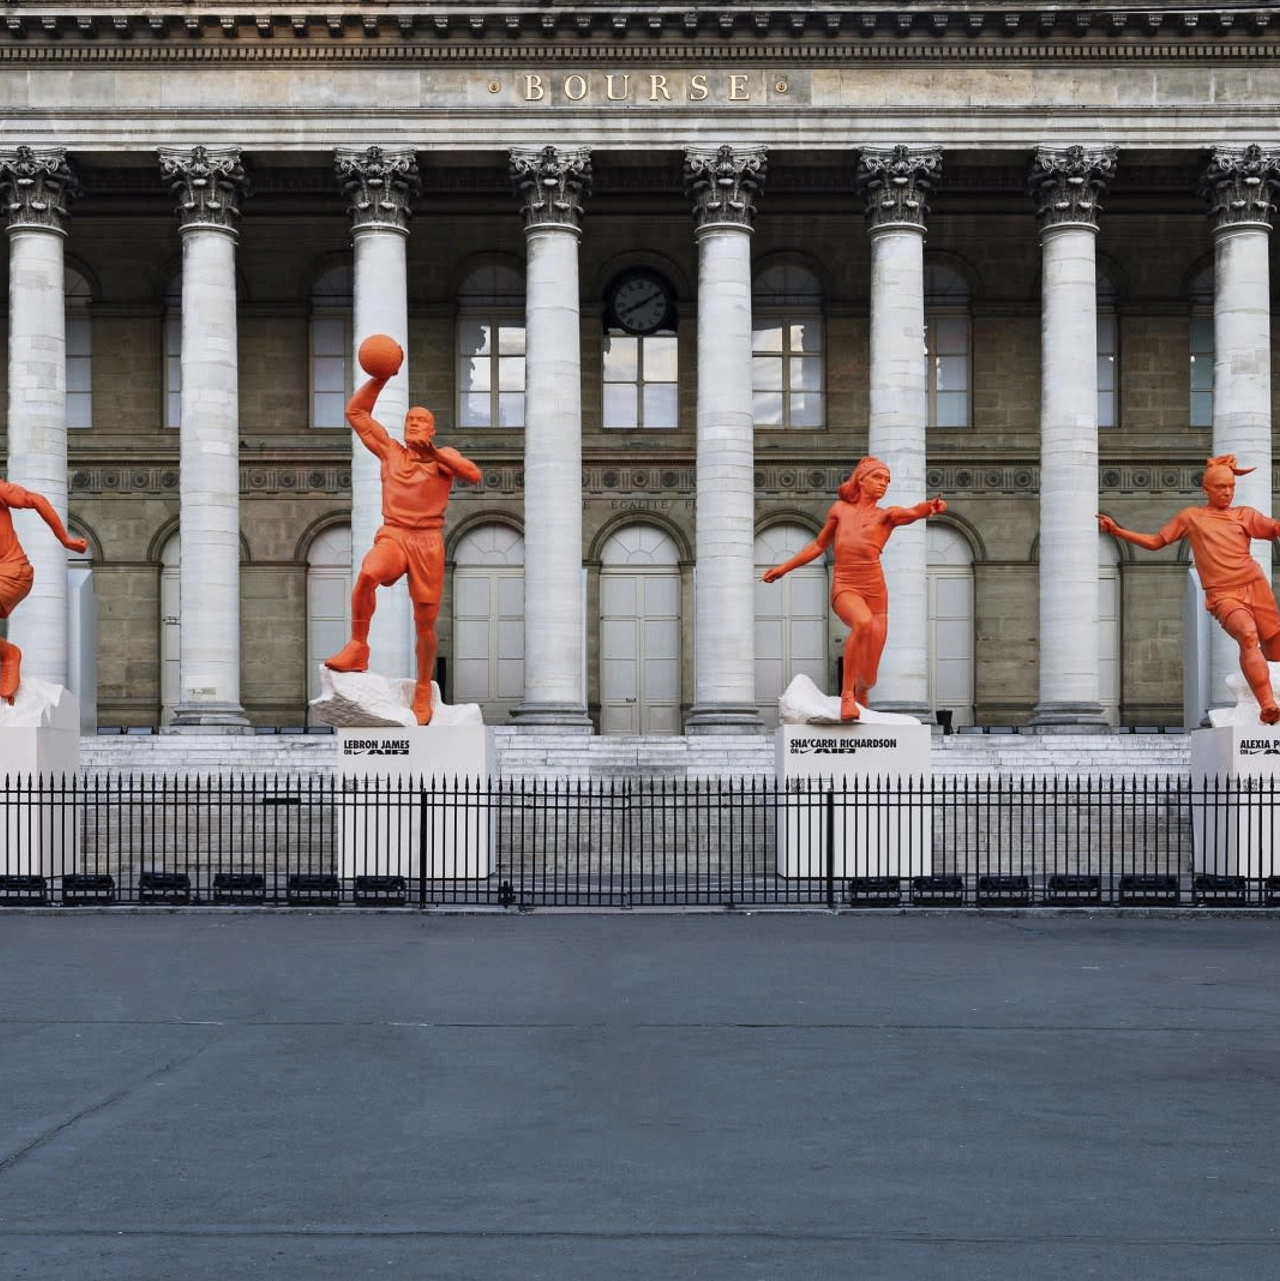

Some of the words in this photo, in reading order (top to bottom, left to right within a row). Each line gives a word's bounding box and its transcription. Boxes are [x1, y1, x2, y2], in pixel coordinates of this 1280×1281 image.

[524, 74, 750, 101] BOURSE
[344, 740, 378, 749] LEBRON
[381, 740, 410, 749] JAMES
[840, 739, 897, 748] RICHARDSON
[1240, 740, 1270, 749] ALEXIA
